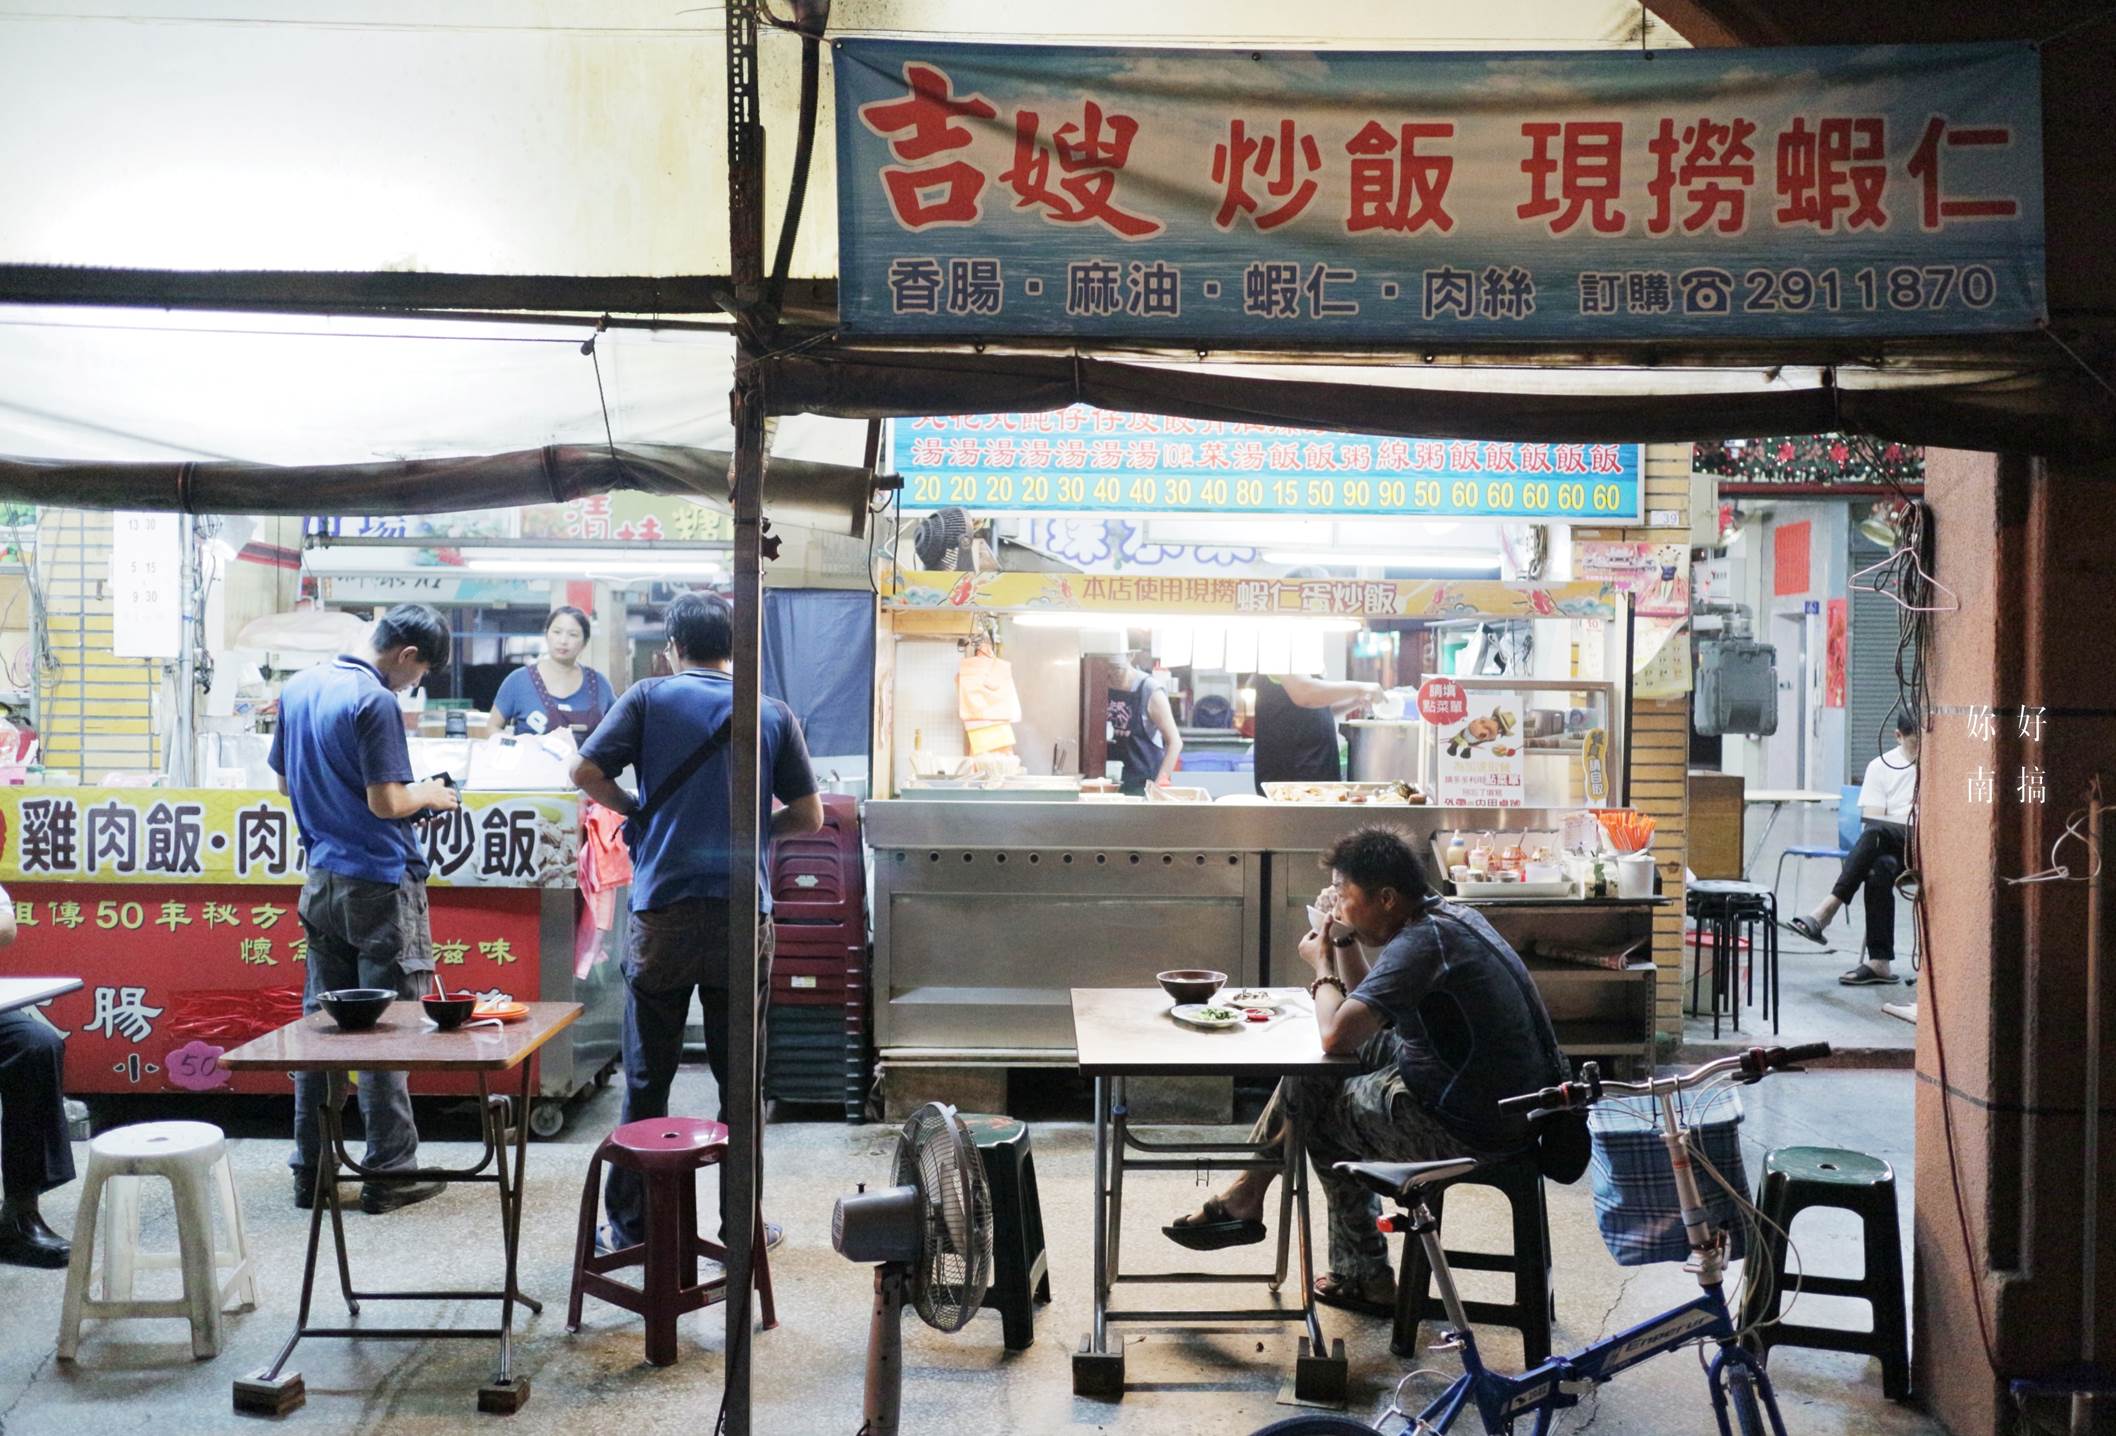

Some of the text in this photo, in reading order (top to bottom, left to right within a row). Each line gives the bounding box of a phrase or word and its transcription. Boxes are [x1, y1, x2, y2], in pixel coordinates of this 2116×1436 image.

[859, 63, 2018, 238] 吉嫂 炒飯 現撈蝦仁
[1744, 265, 1998, 313] 2911870
[913, 475, 1620, 510] 20 20 20 20 30 40 40 30 40 80 15 50 90 90 50 60 60 60 60 60
